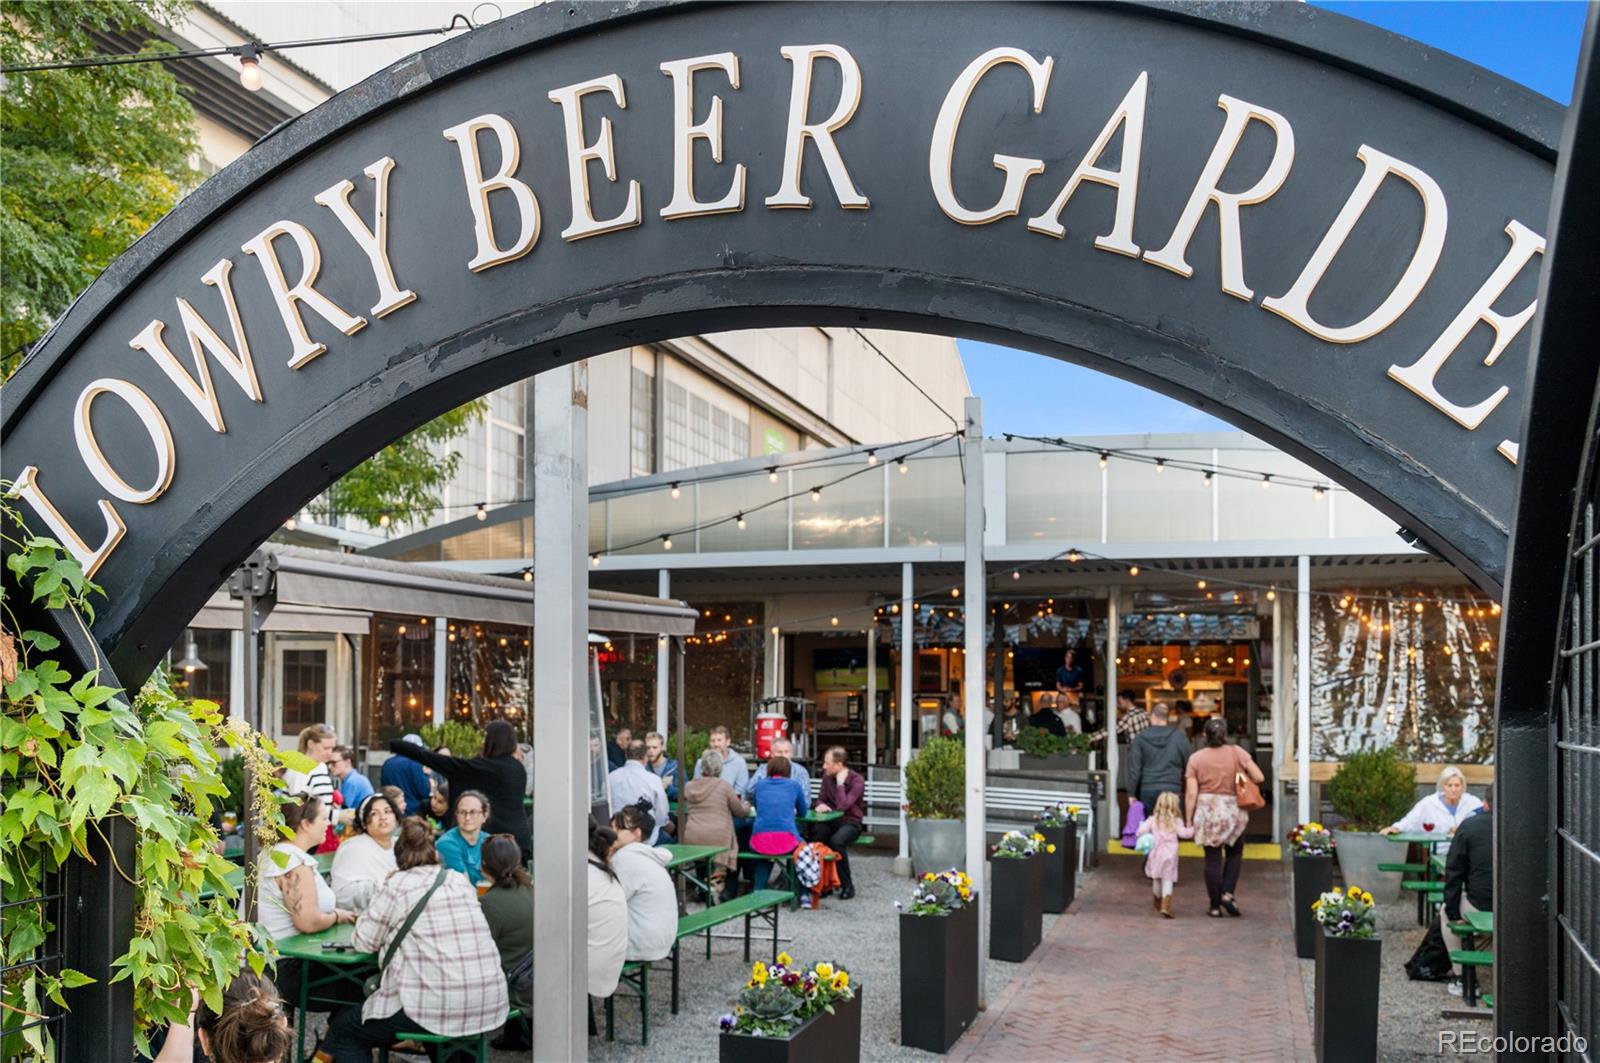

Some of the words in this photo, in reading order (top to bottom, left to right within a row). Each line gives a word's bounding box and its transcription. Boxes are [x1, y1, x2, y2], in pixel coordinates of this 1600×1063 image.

[5, 156, 417, 580] LOWRY
[443, 44, 870, 272] BEER
[929, 46, 1547, 465] GARDE
